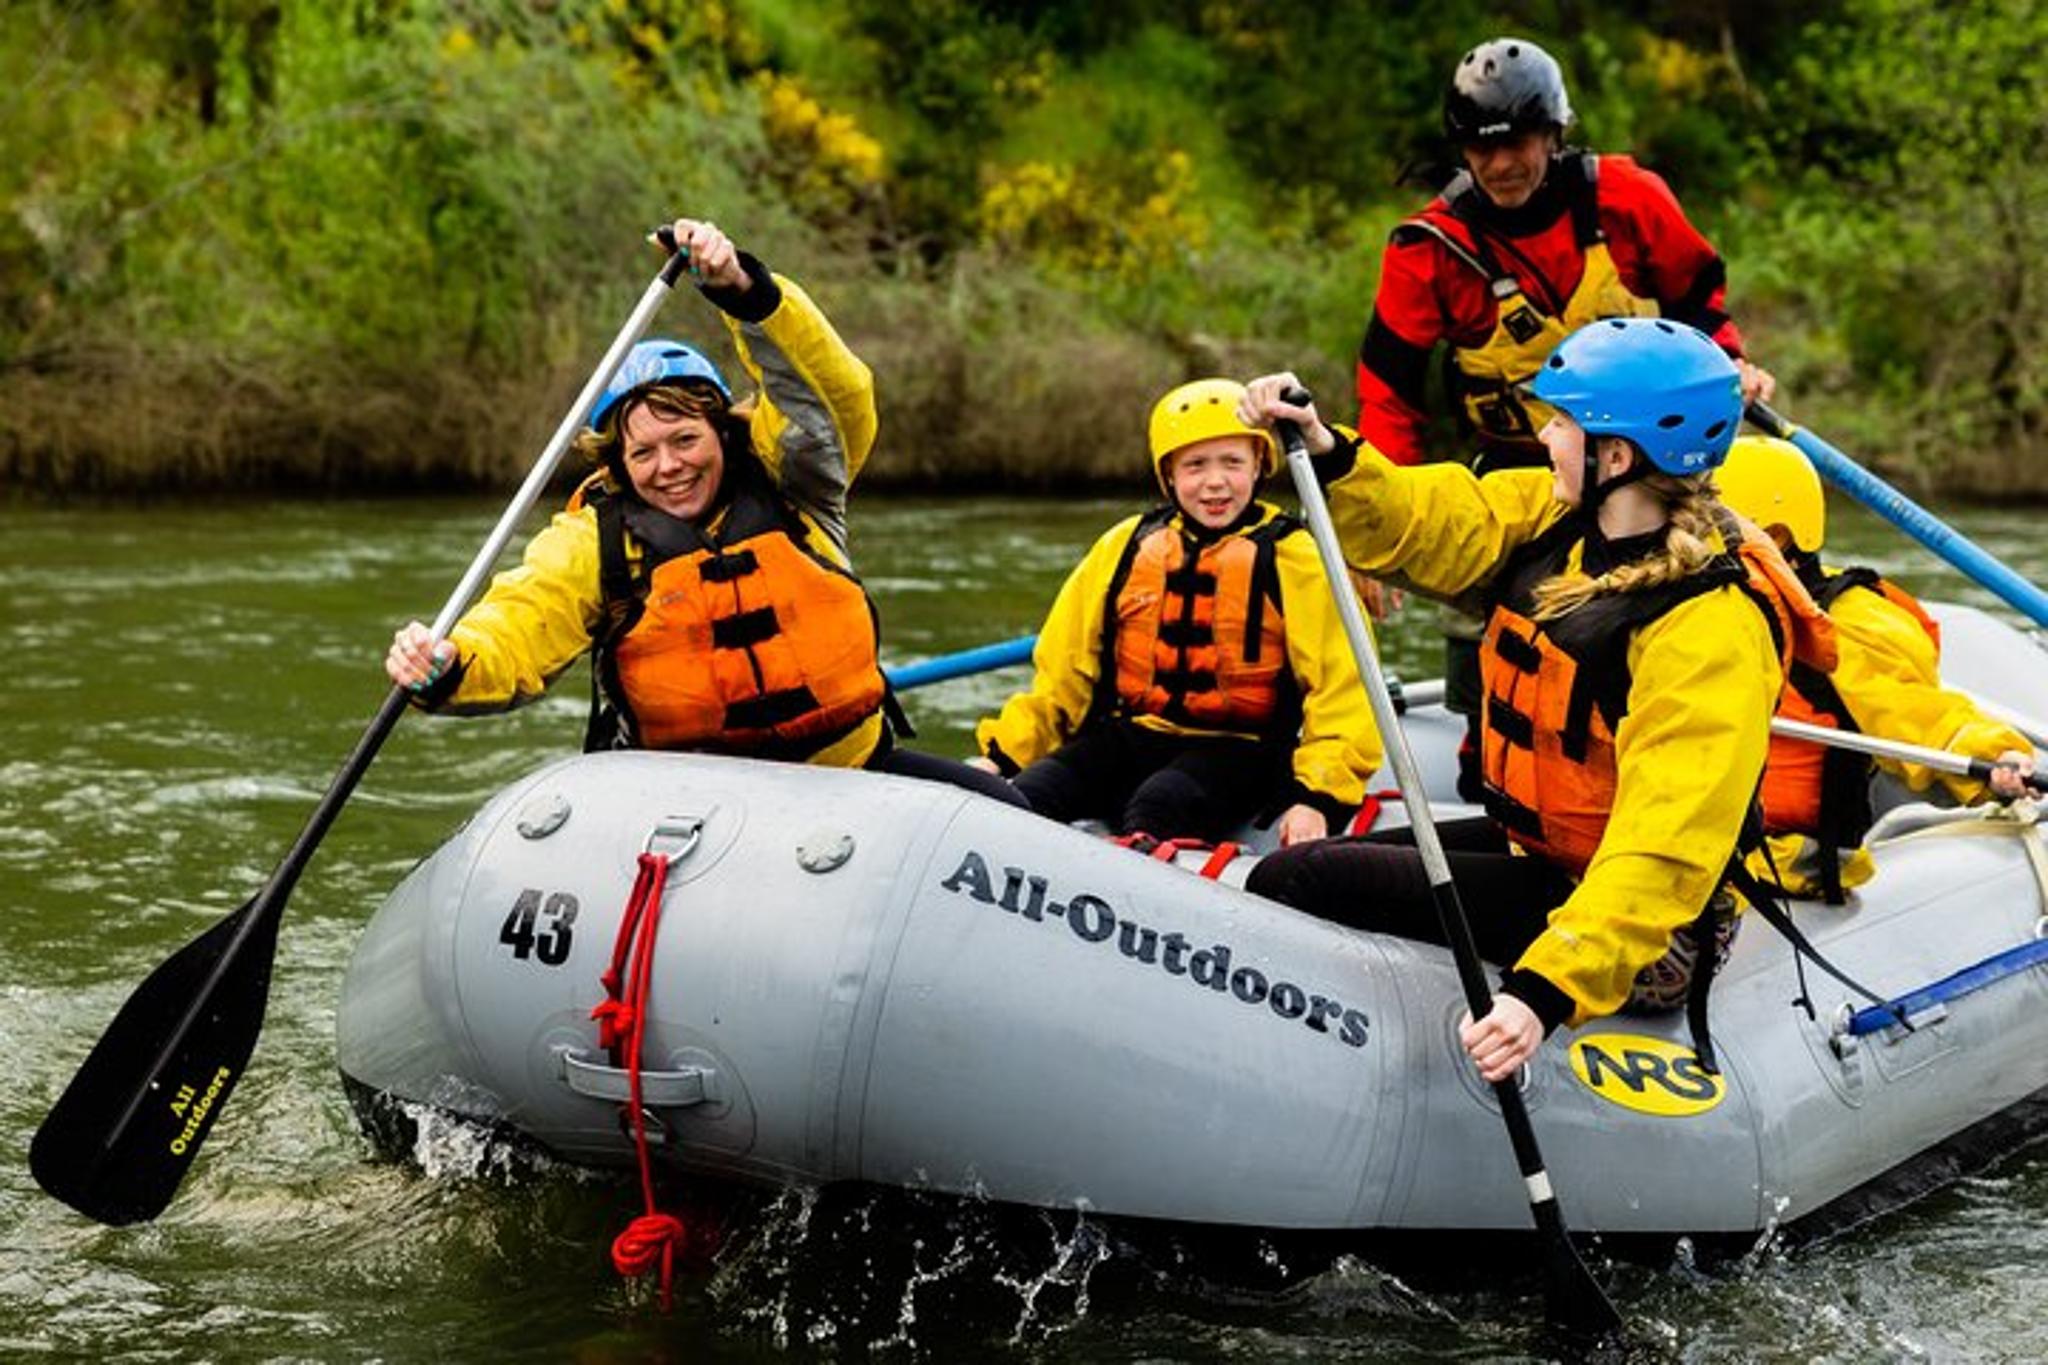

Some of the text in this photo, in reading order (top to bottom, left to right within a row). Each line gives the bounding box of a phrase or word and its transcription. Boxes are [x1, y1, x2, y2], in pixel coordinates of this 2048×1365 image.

[499, 888, 580, 967] 43
[941, 850, 1370, 1048] All-Outdoors
[169, 1084, 197, 1118] All
[169, 1066, 232, 1156] Outdoors
[1581, 1043, 1718, 1101] NRS
